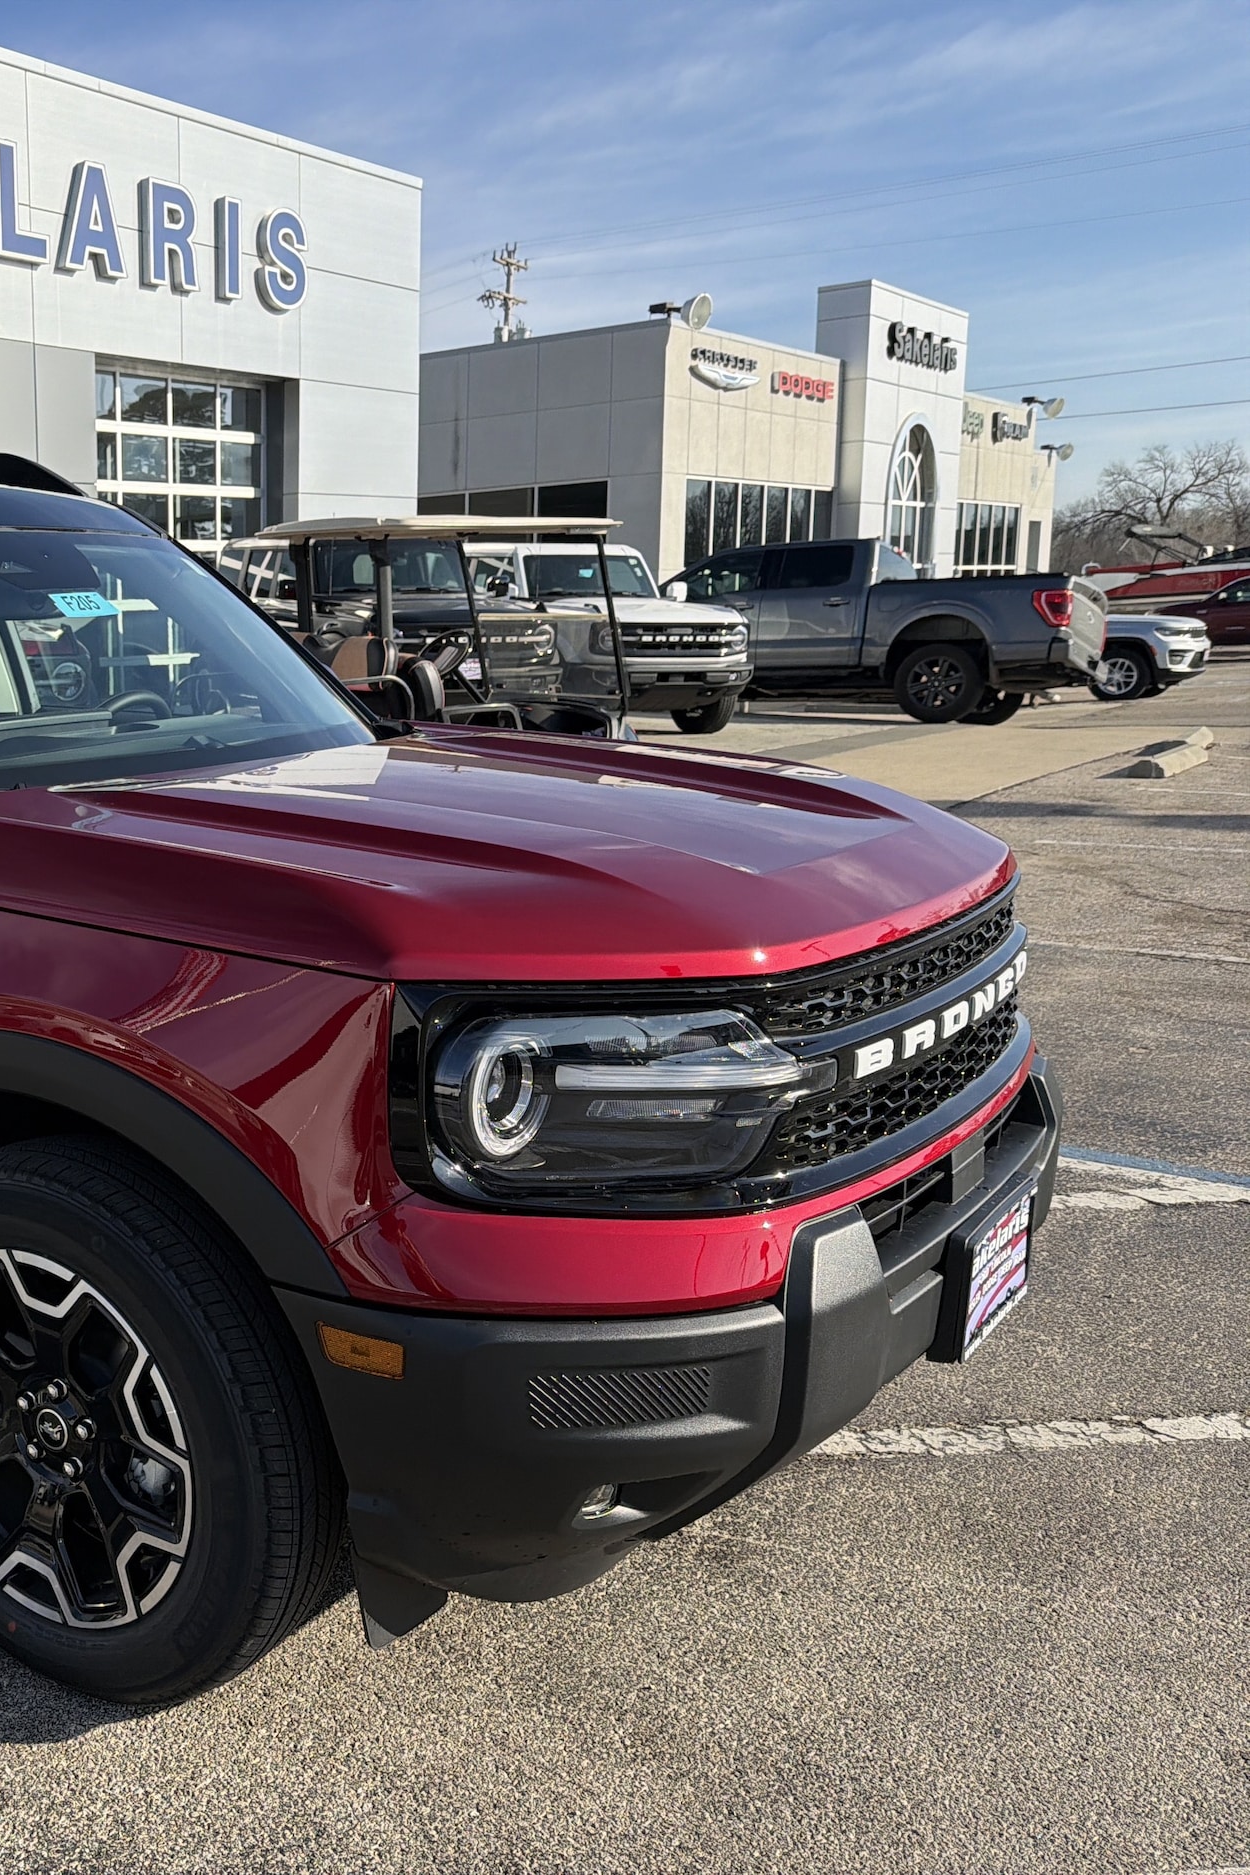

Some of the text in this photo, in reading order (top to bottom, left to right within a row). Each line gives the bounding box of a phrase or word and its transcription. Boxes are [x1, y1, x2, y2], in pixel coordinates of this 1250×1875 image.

[888, 321, 957, 372] Sakelaris
[775, 371, 834, 401] DODGE
[60, 596, 101, 612] F205
[853, 951, 1028, 1080] BRONCO
